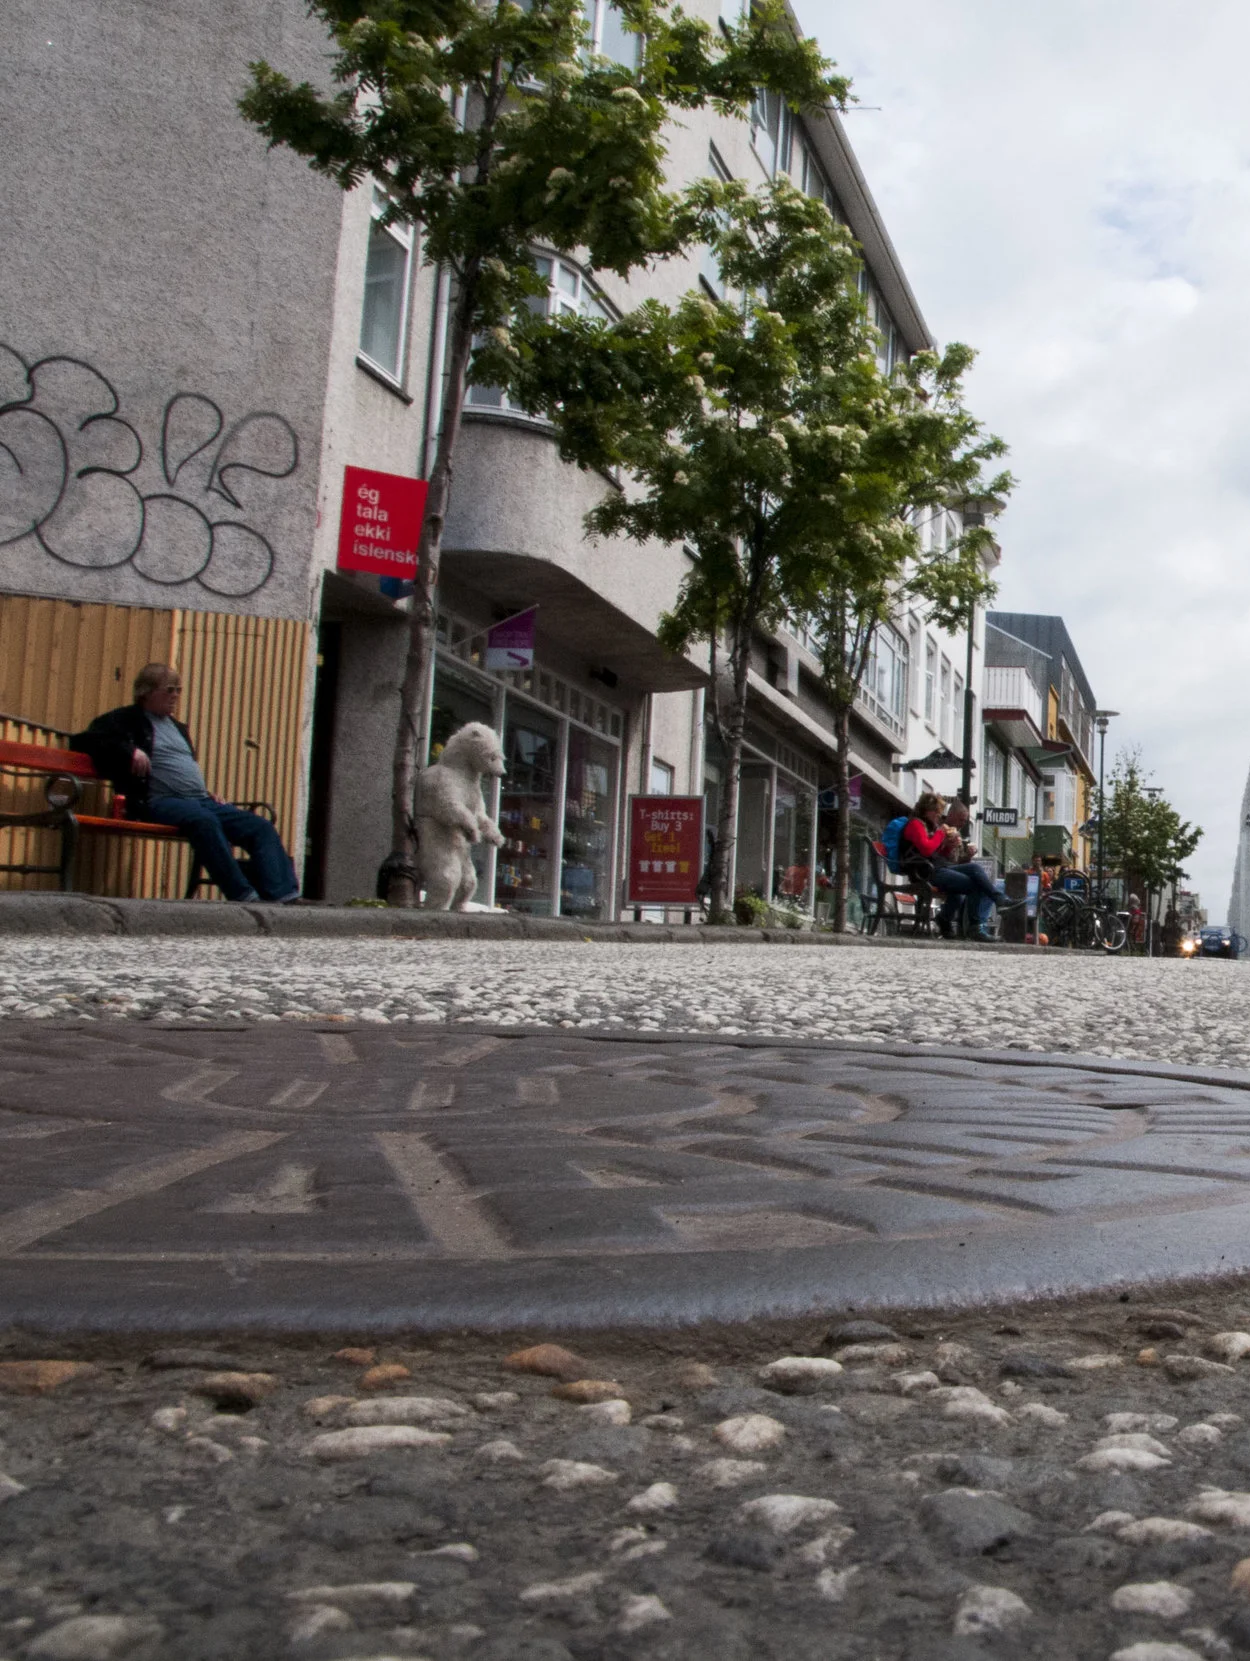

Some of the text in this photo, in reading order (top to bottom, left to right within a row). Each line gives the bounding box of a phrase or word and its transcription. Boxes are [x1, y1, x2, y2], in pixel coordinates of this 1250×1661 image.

[357, 483, 380, 505] ég
[356, 503, 389, 522] tala
[354, 522, 391, 542] ekki
[639, 808, 694, 821] T-shirts:
[986, 809, 1016, 824] KILROY
[650, 820, 682, 833] Buy 3
[1070, 879, 1078, 889] P
